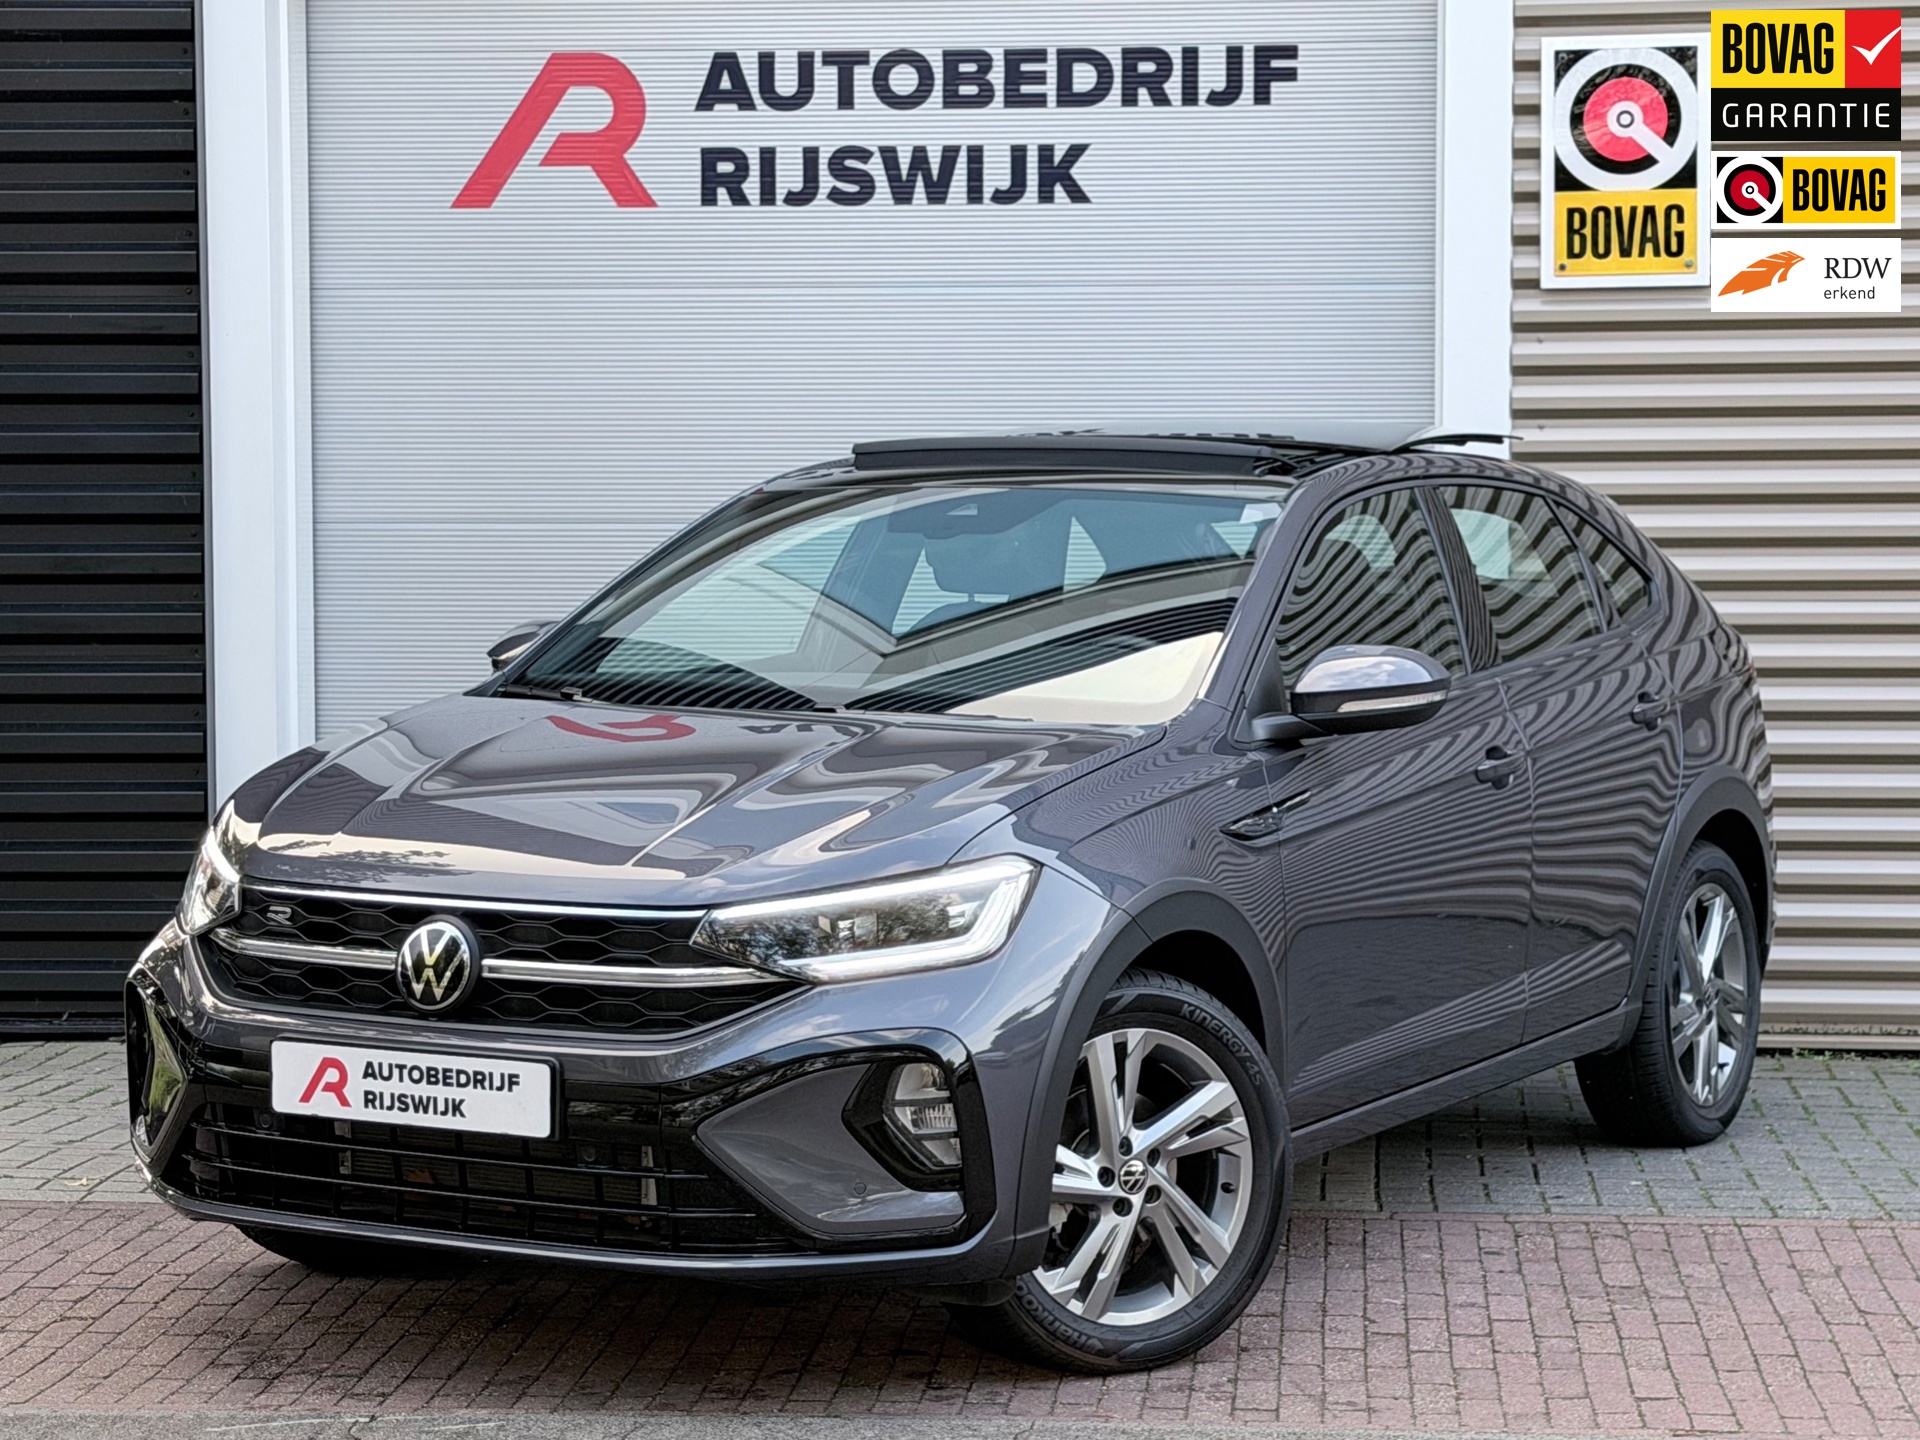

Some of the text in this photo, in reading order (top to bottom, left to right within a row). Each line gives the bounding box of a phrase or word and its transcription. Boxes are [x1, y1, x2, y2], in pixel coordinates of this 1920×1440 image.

[694, 44, 1299, 112] AUTOBEDRIJF
[700, 143, 1092, 207] RIJSWIJK
[1566, 203, 1685, 260] BOVAG
[362, 1060, 521, 1092] AUTOBEDRIJF
[363, 1089, 467, 1118] RIJSWIJK
